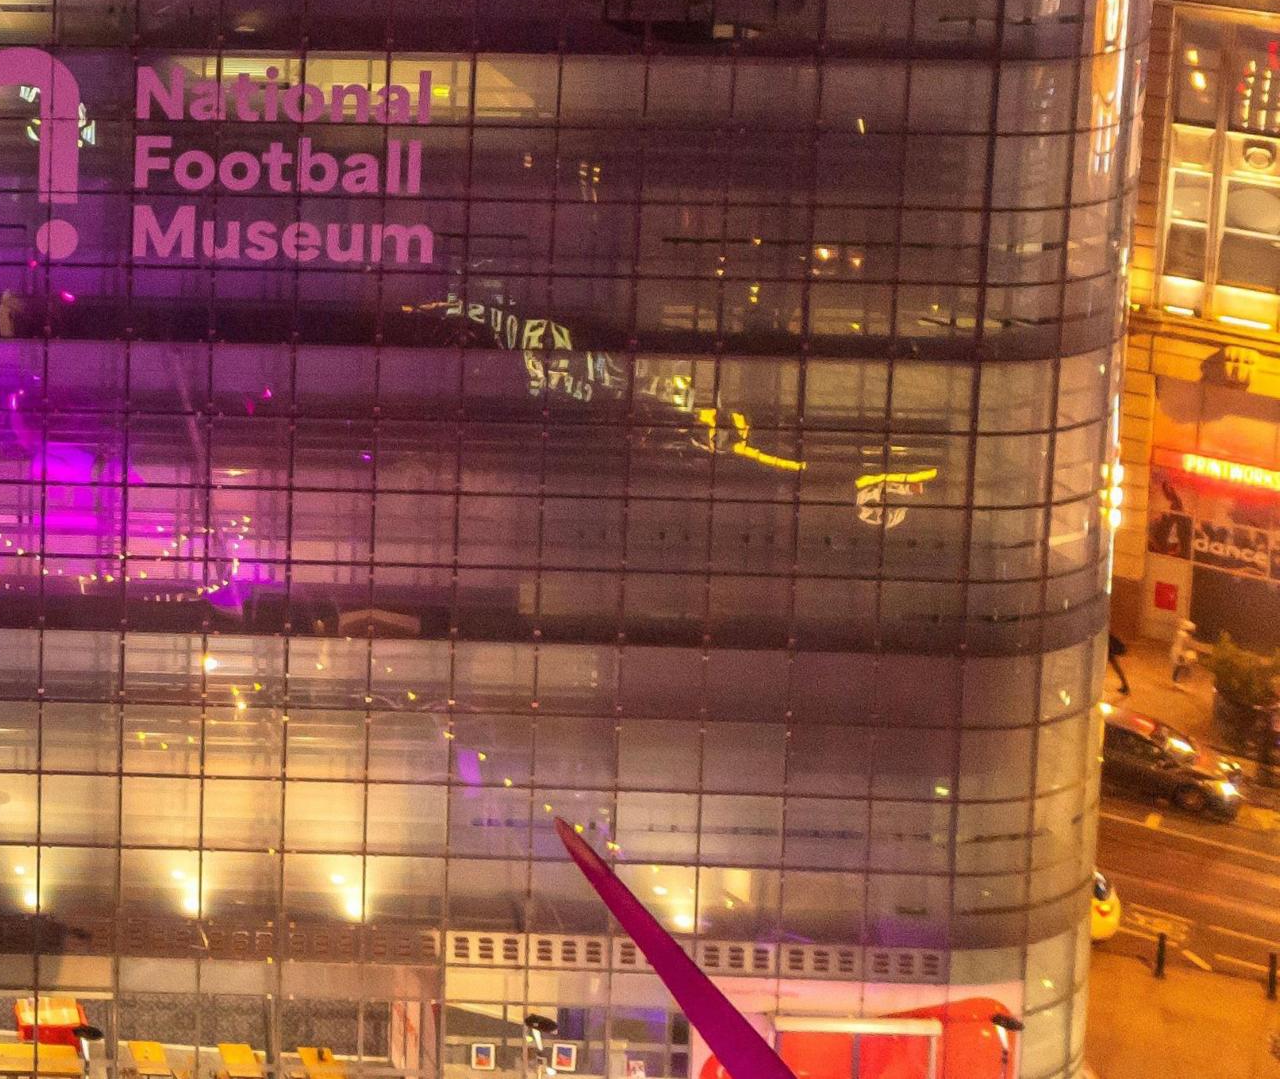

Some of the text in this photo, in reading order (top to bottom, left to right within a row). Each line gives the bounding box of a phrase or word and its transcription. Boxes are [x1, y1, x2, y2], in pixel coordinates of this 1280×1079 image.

[136, 65, 433, 123] National
[134, 136, 422, 194] Football
[132, 205, 434, 264] Museum
